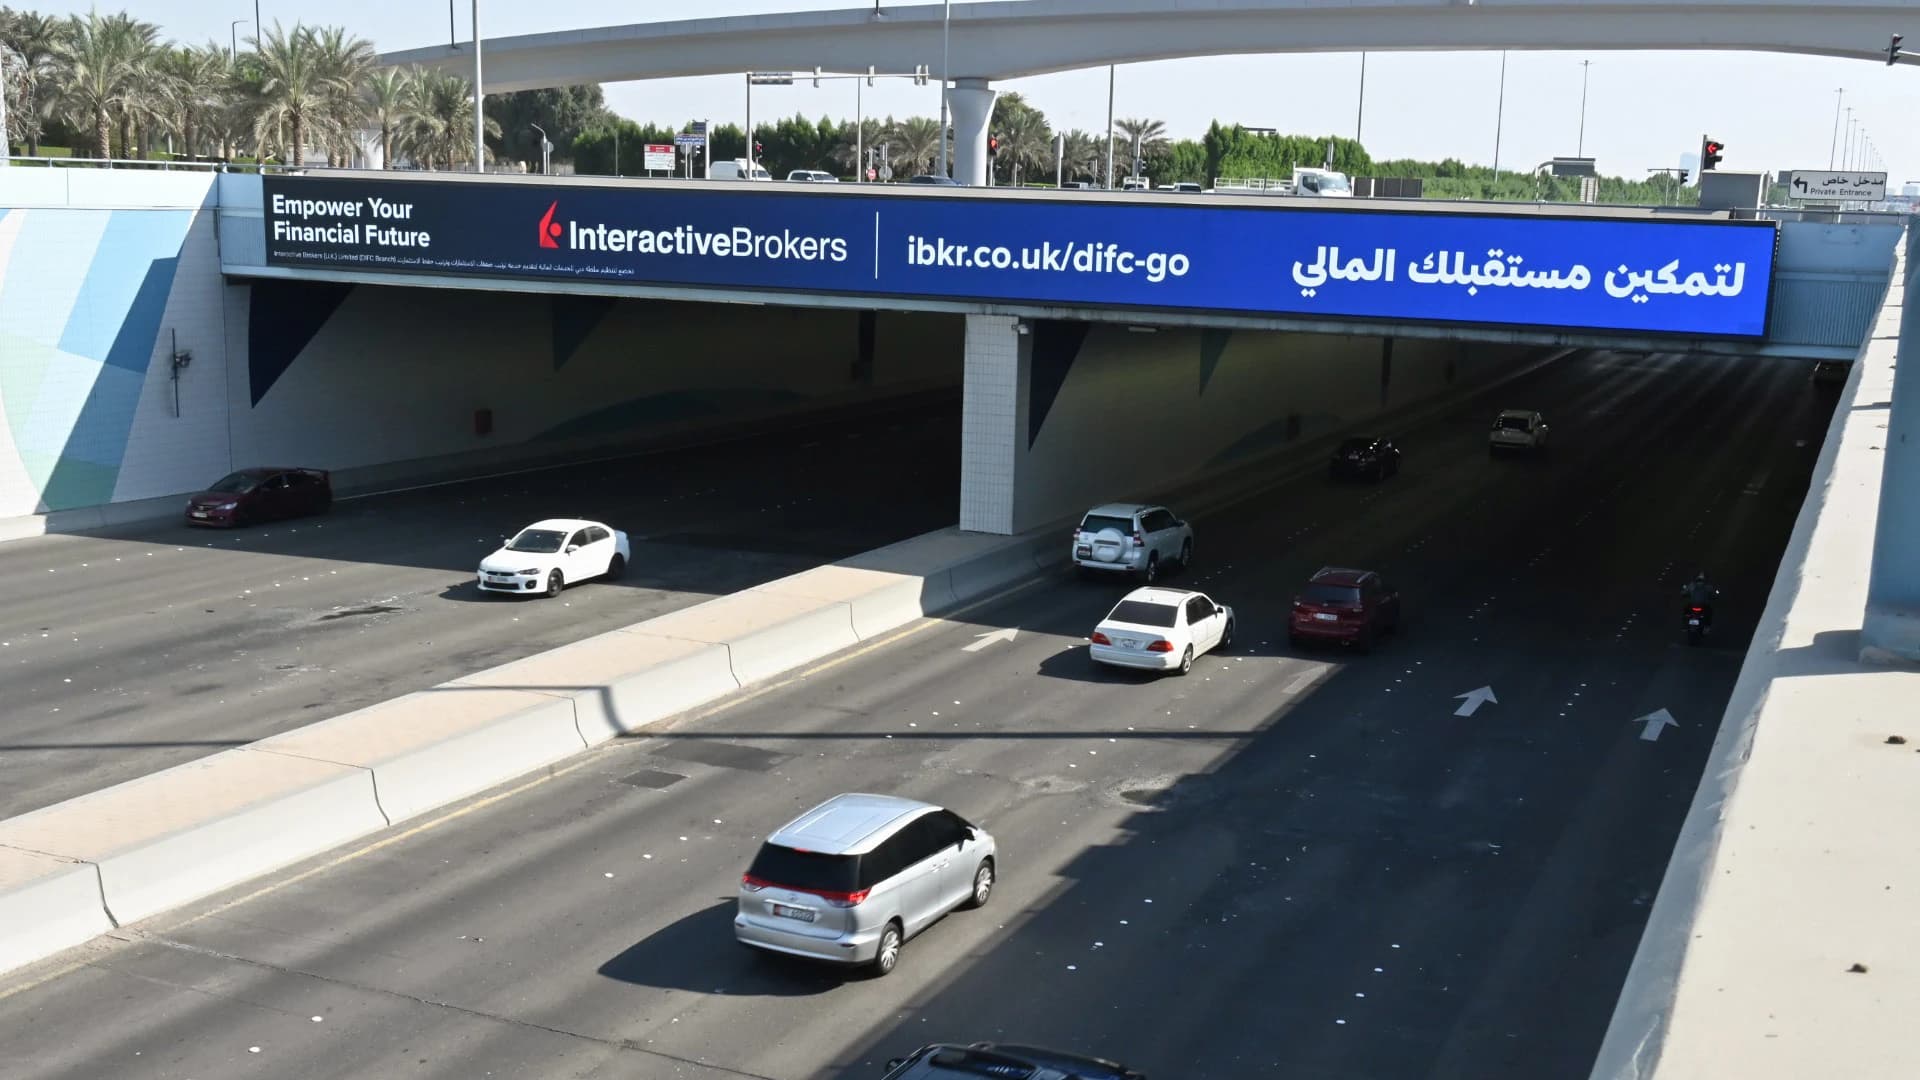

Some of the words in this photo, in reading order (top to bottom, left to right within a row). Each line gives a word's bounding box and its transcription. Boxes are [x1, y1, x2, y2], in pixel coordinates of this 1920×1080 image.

[1810, 188, 1836, 196] Private
[1839, 188, 1872, 196] Entrance
[1822, 176, 1849, 186] خاص
[1853, 176, 1884, 187] مدخل
[273, 194, 363, 220] Empower
[368, 197, 413, 220] Your
[274, 220, 359, 245] Financial
[366, 224, 431, 248] Future
[570, 220, 848, 262] InteractiveBrokers
[907, 235, 1190, 283] ibkr.co.uk/difc-go
[1292, 245, 1396, 297] المالي
[1408, 248, 1591, 297] مستقبلك
[1604, 259, 1746, 304] لتمكين
